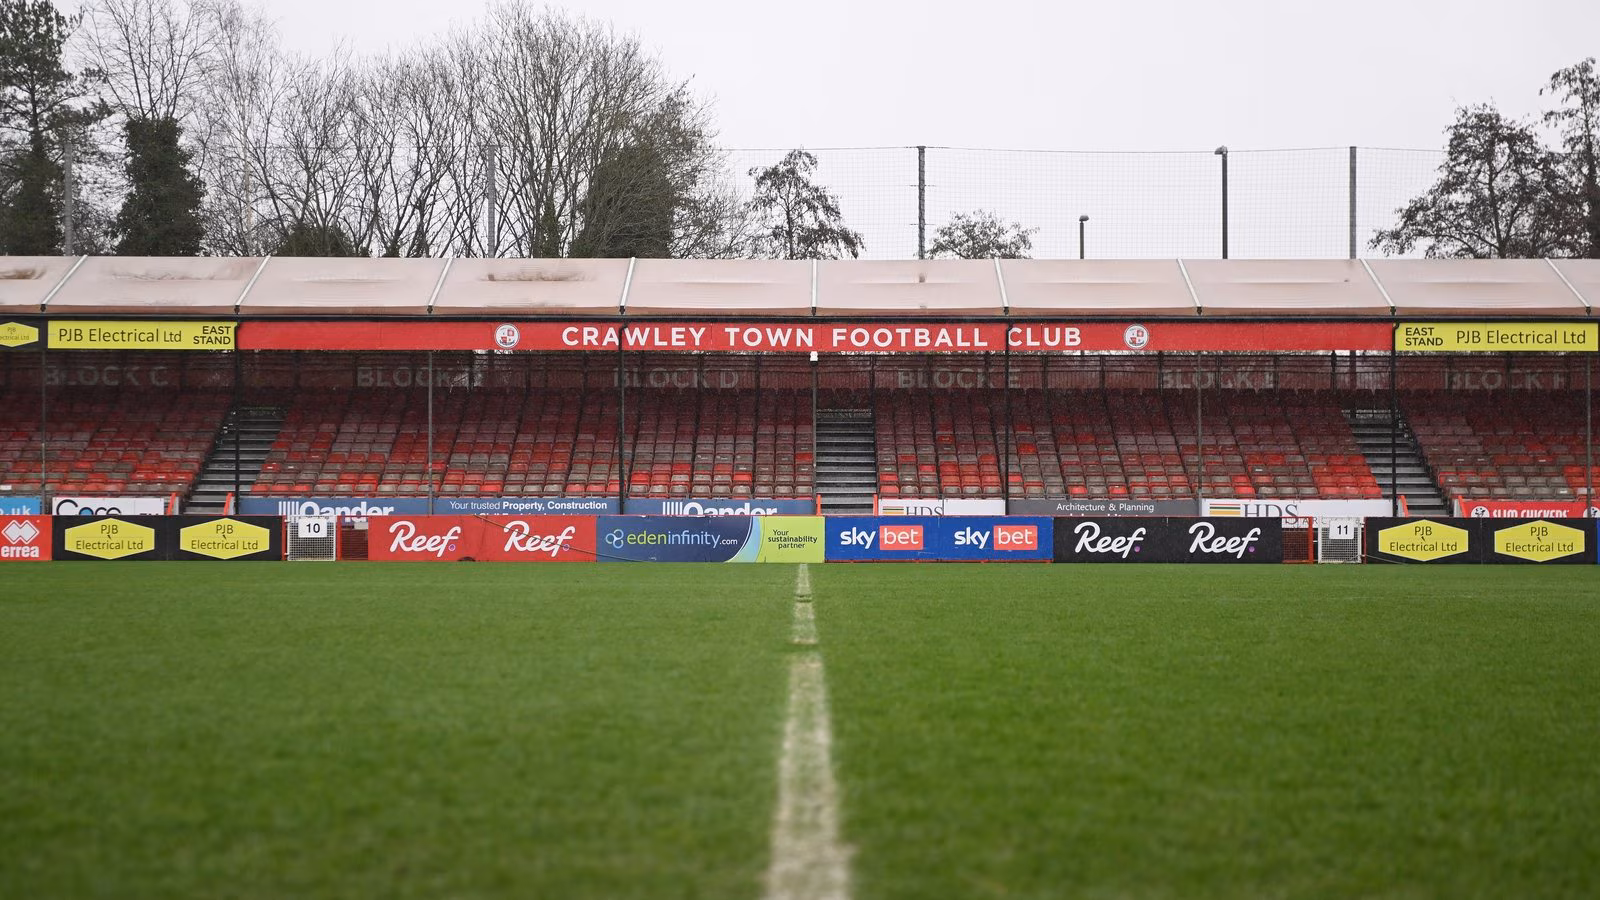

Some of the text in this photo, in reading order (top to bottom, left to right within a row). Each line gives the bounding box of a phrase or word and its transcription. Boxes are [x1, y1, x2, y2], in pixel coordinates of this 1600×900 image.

[59, 328, 182, 342] PJB Electrical Ltd
[202, 326, 231, 334] EAST
[1405, 327, 1434, 336] EAST
[193, 336, 231, 345] STAND
[562, 327, 1081, 347] CRAWLEY TOWN FOOTBALL CLUB
[1405, 337, 1443, 346] STAND
[1456, 330, 1586, 344] PJB Electrical Ltd
[613, 367, 739, 388] BLOCK D
[898, 368, 1000, 388] BLOCK
[450, 501, 607, 511] Your trusted Property, Construction
[1056, 503, 1154, 513] Architecture & Planning
[101, 525, 118, 534] PJB
[216, 525, 233, 534] PJB
[306, 523, 320, 533] 10
[1337, 525, 1349, 534] 11
[1415, 526, 1432, 536] PJB
[1531, 527, 1548, 536] PJB
[389, 520, 461, 557] Reef
[503, 520, 576, 557] Reef
[627, 530, 738, 548] edeninfinity.com
[768, 536, 818, 544] sustainability
[840, 526, 919, 549] sky bet
[954, 526, 1033, 549] sky bet
[1074, 521, 1146, 558] Reef
[1188, 521, 1261, 558] Reef
[76, 540, 143, 550] Electrical Ltd
[191, 540, 258, 550] Electrical Ltd
[1390, 542, 1457, 551] Electrical Ltd
[1506, 542, 1574, 552] Electrical Ltd
